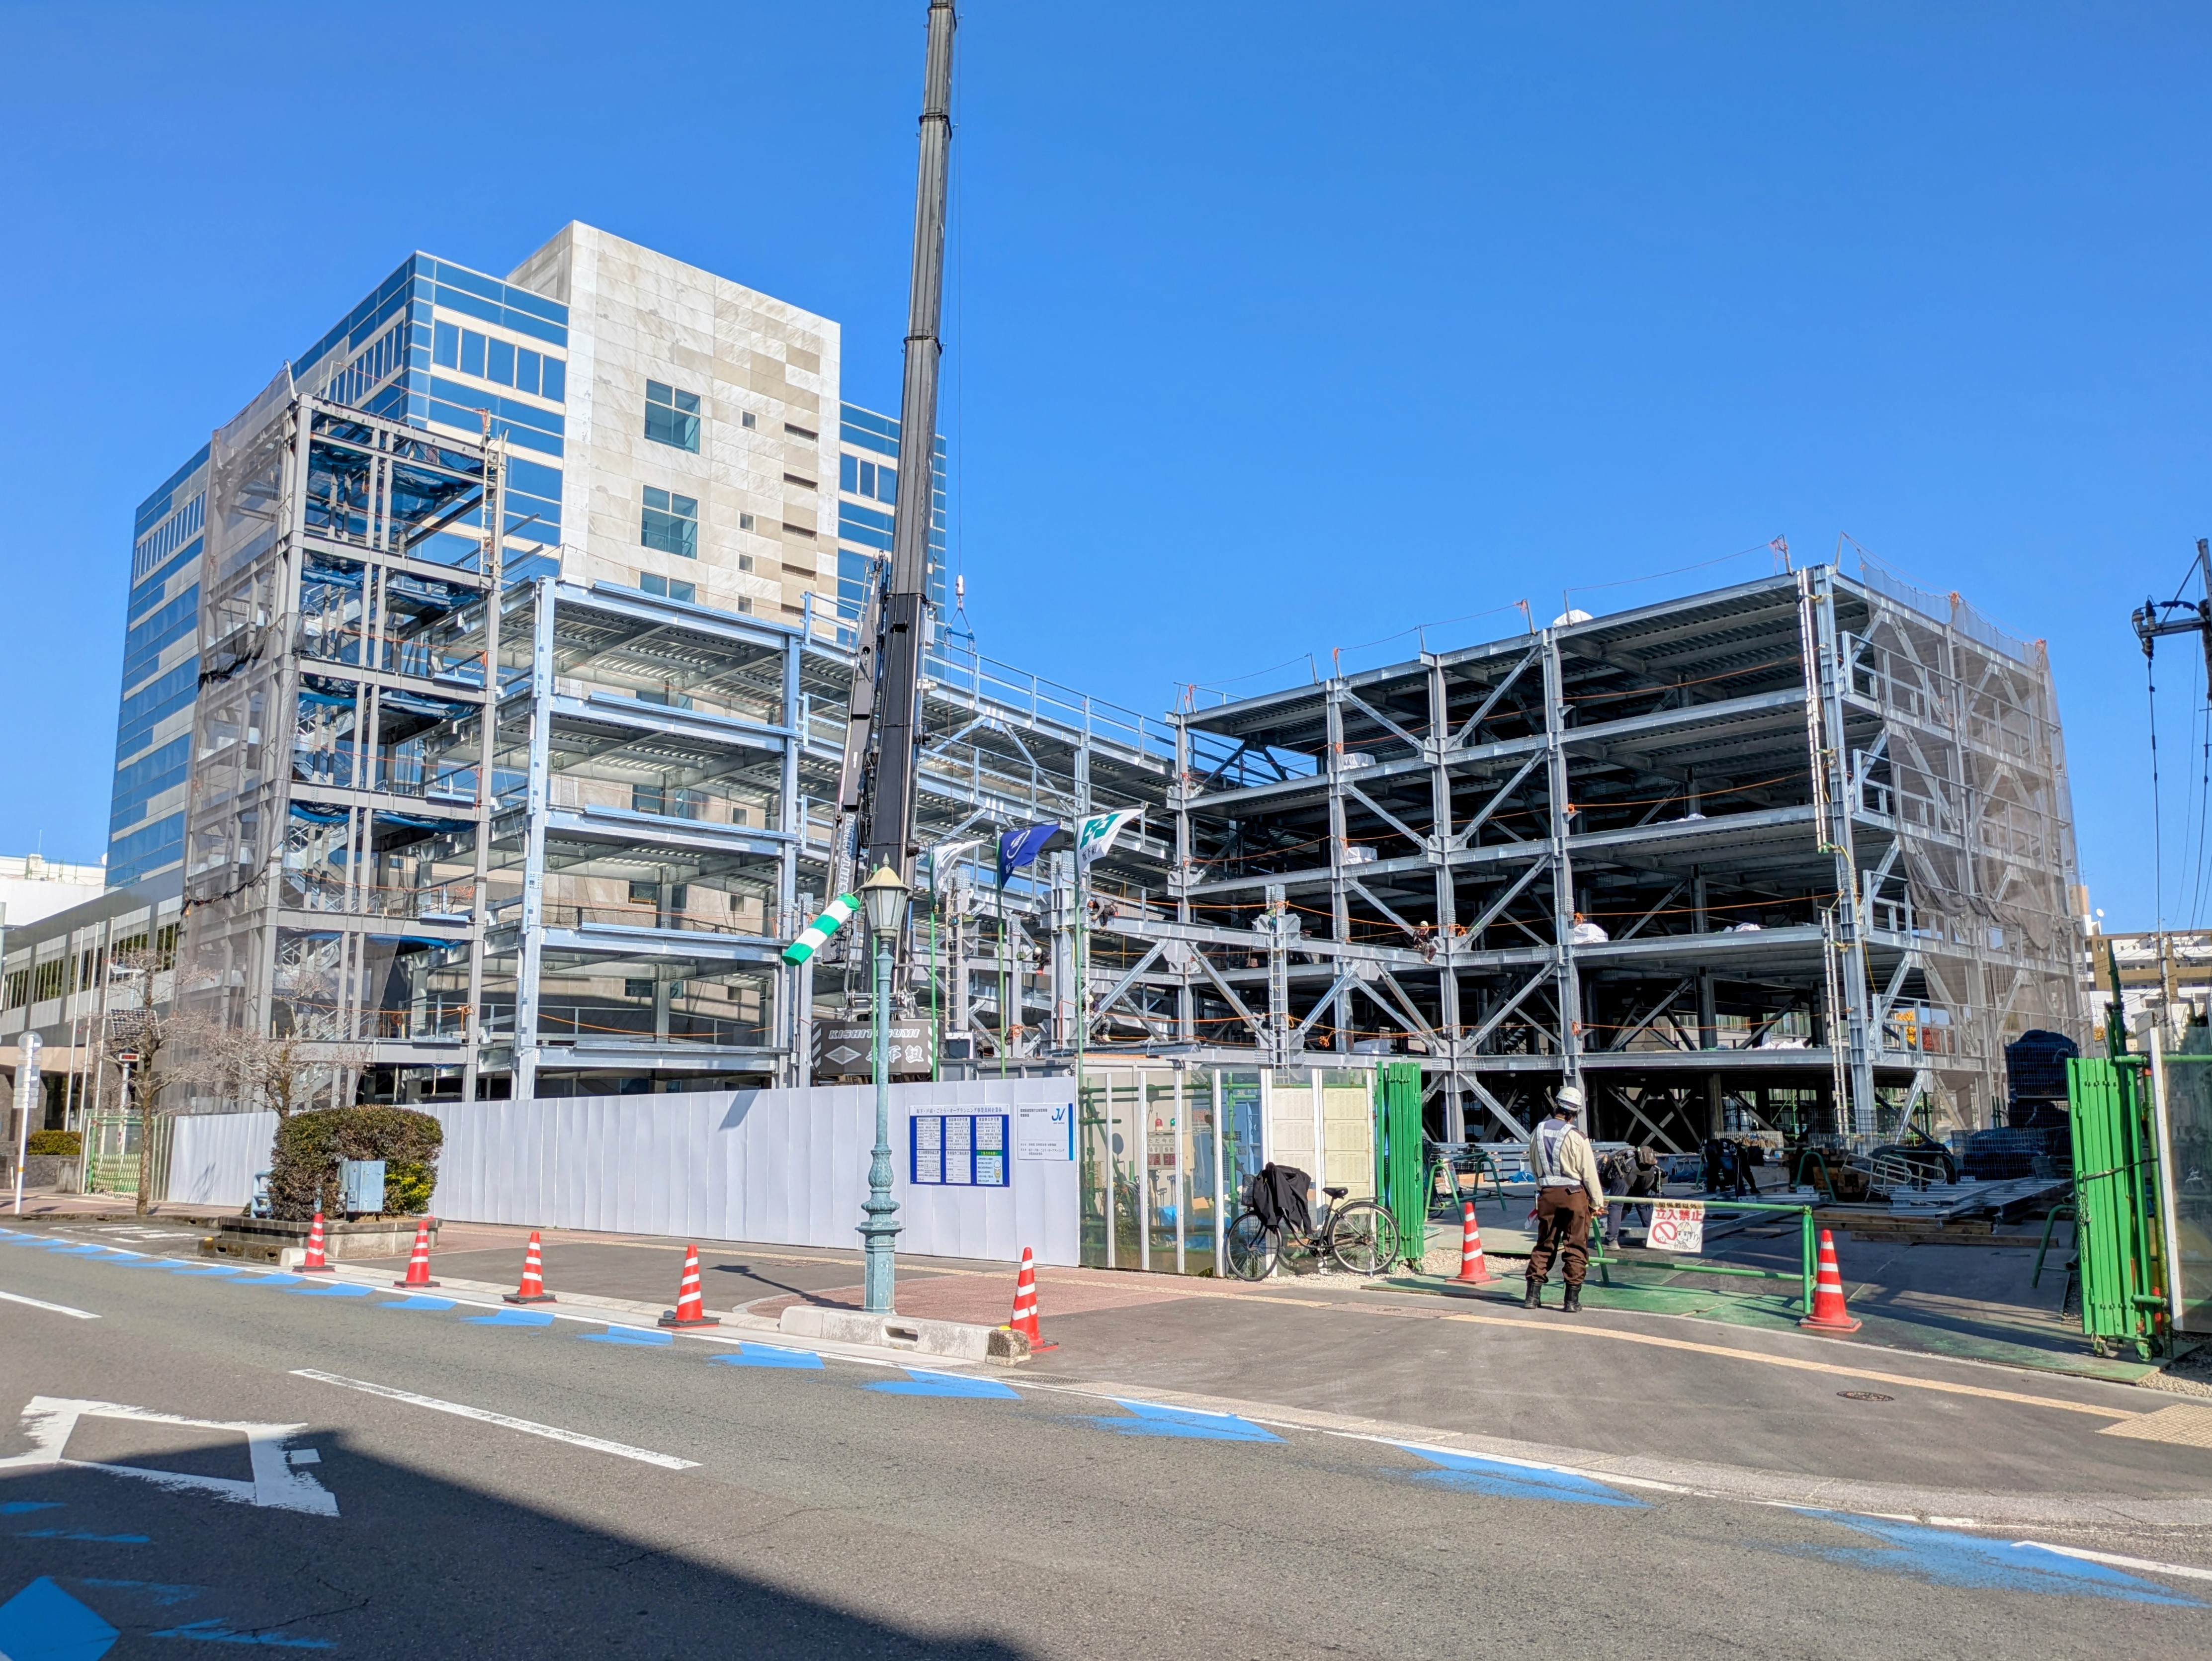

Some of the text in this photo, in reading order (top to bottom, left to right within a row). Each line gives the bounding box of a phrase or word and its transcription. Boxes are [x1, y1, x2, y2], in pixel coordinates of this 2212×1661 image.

[837, 812, 855, 896] SHITAGUMI
[828, 1029, 920, 1040] KISHITUMI
[1052, 1108, 1065, 1121] JV
[1655, 1209, 1702, 1221] 立入禁止
